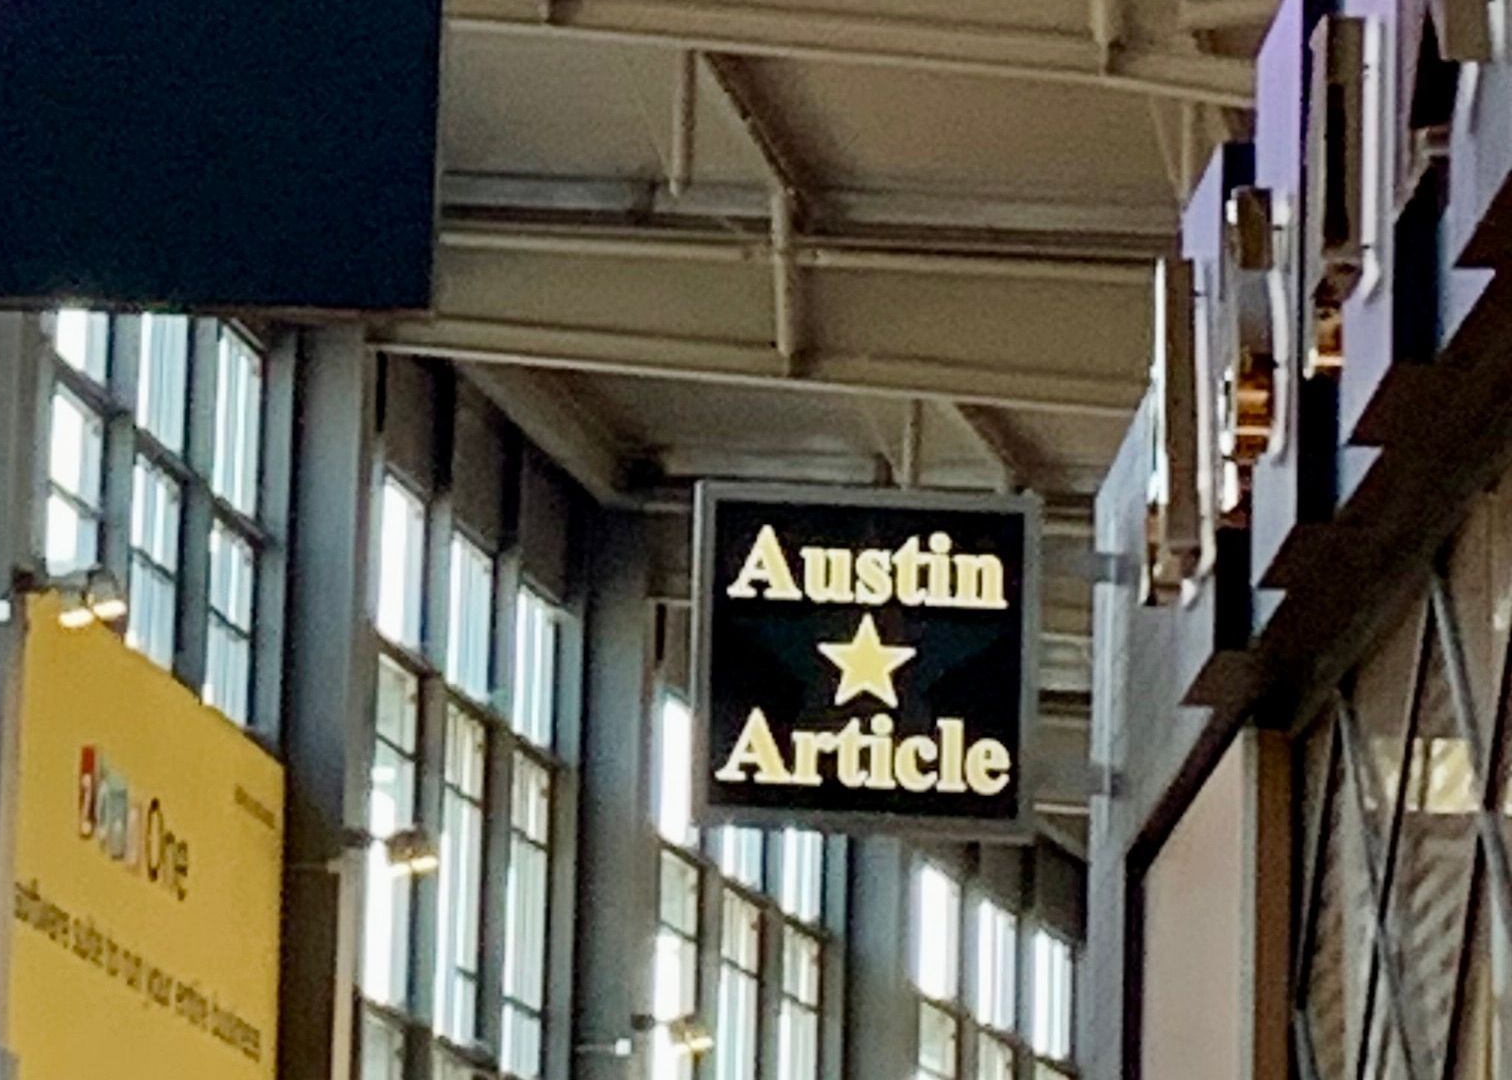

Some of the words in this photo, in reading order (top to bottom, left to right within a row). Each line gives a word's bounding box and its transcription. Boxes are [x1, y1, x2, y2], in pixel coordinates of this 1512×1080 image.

[726, 523, 1009, 609] Austin
[715, 705, 1012, 796] Article
[144, 796, 189, 903] One
